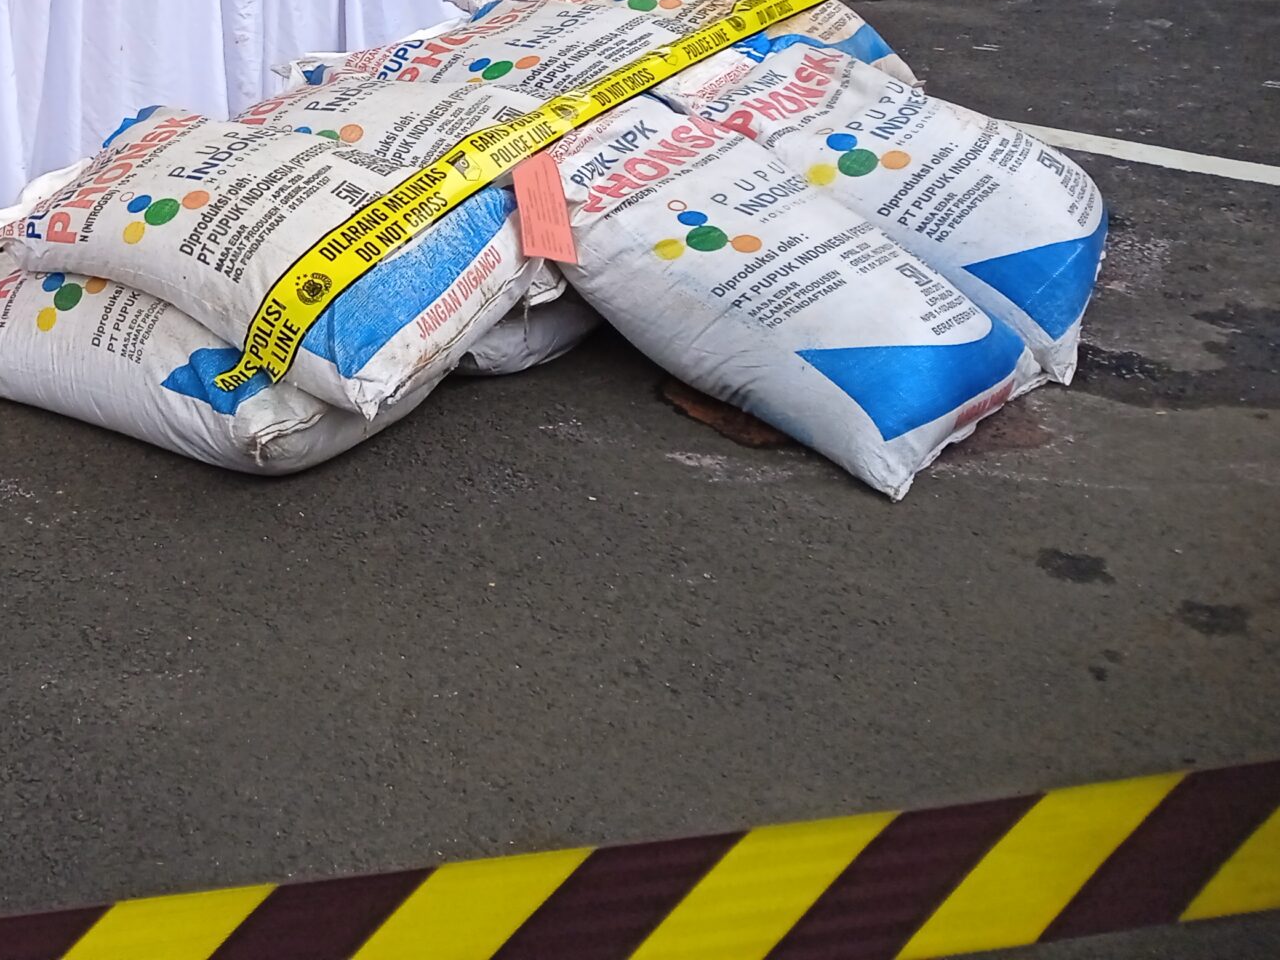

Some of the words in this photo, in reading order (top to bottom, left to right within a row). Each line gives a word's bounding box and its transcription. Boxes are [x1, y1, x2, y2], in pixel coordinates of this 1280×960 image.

[534, 61, 575, 90] PUPUK
[567, 32, 621, 62] INDONESIA
[592, 89, 612, 106] DO
[608, 81, 625, 100] NOT
[622, 68, 655, 91] CROSS
[394, 113, 415, 133] oleh
[410, 100, 457, 140] INDONESIA
[470, 125, 510, 153] GARIS
[490, 134, 533, 168] POLICE
[528, 120, 557, 149] LINE
[608, 120, 658, 154] NPK
[271, 185, 288, 203] APRIL
[304, 165, 333, 190] INDONESIA
[877, 161, 934, 218] Diproduksi
[931, 145, 952, 166] oleh
[897, 209, 918, 227] PT
[913, 174, 955, 211] PUPUK
[950, 130, 994, 177] INDONESIA
[180, 192, 233, 257] Diproduksi
[229, 178, 253, 201] oleh
[197, 244, 217, 266] PT
[209, 202, 249, 245] PUPUK
[242, 161, 299, 210] INDONESIA
[320, 208, 389, 262] DILARANG
[383, 167, 448, 215] MELINTAS
[355, 242, 382, 263] DO
[376, 221, 408, 247] NOT
[403, 191, 449, 229] CROSS
[915, 210, 935, 234] MASA
[933, 192, 958, 214] EDAR
[926, 206, 957, 239] ALAMAT
[952, 174, 994, 210] PRODUSEN
[935, 229, 952, 243] NO.
[948, 181, 1000, 230] PENDAFTARAN
[79, 233, 89, 242] N
[214, 245, 234, 272] MASA
[230, 223, 250, 246] EDAR
[224, 243, 247, 278] ALAMAT
[244, 203, 281, 244] PRODUSEN
[232, 266, 243, 283] NO.
[241, 213, 288, 267] PENDAFTARAN
[416, 298, 461, 340] JANGAN
[457, 245, 502, 304] DIGANCU
[711, 249, 780, 298] Diproduksi
[780, 236, 804, 254] oleh
[732, 293, 753, 310] PT
[749, 263, 798, 297] PUPUK
[794, 233, 853, 269] INDONESIA
[91, 285, 126, 348] Diproduksi
[106, 335, 121, 354] PT
[116, 290, 142, 334] PUPUK
[748, 293, 772, 318] MASA
[770, 281, 801, 302] EDAR
[758, 297, 798, 325] ALAMAT
[791, 269, 841, 302] PRODUSEN
[767, 317, 784, 330] NO.
[784, 278, 848, 320] PENDAFTARAN
[120, 332, 134, 358] MASA
[129, 308, 145, 332] EDAR
[128, 325, 145, 361] ALAMAT
[135, 349, 144, 365] NO.
[249, 298, 287, 360] POLISI
[274, 318, 301, 357] LINE
